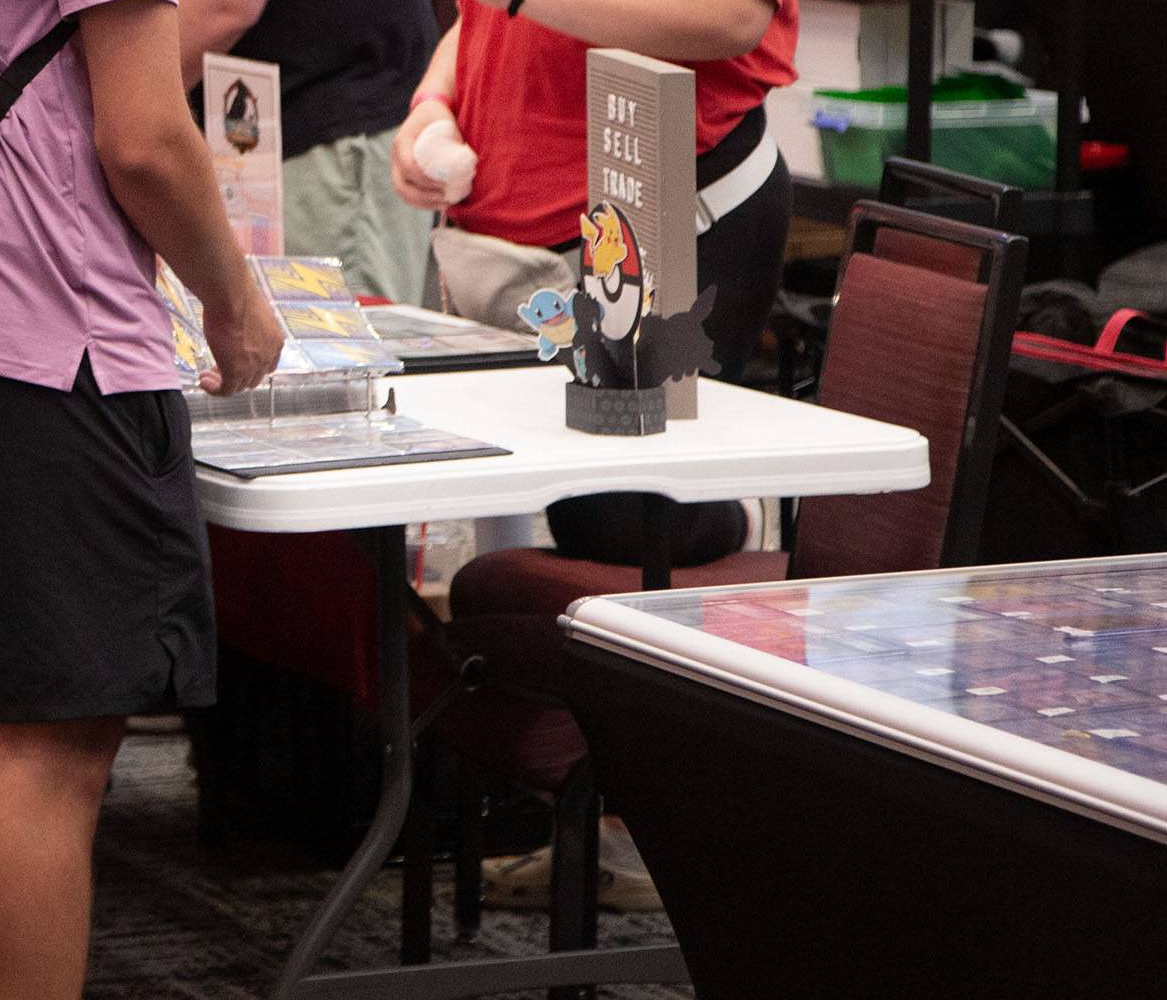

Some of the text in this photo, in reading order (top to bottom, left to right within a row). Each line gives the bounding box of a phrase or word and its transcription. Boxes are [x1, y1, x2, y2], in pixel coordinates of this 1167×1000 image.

[608, 94, 637, 126] BUY
[603, 127, 642, 165] SELL
[602, 167, 643, 208] TRADE
